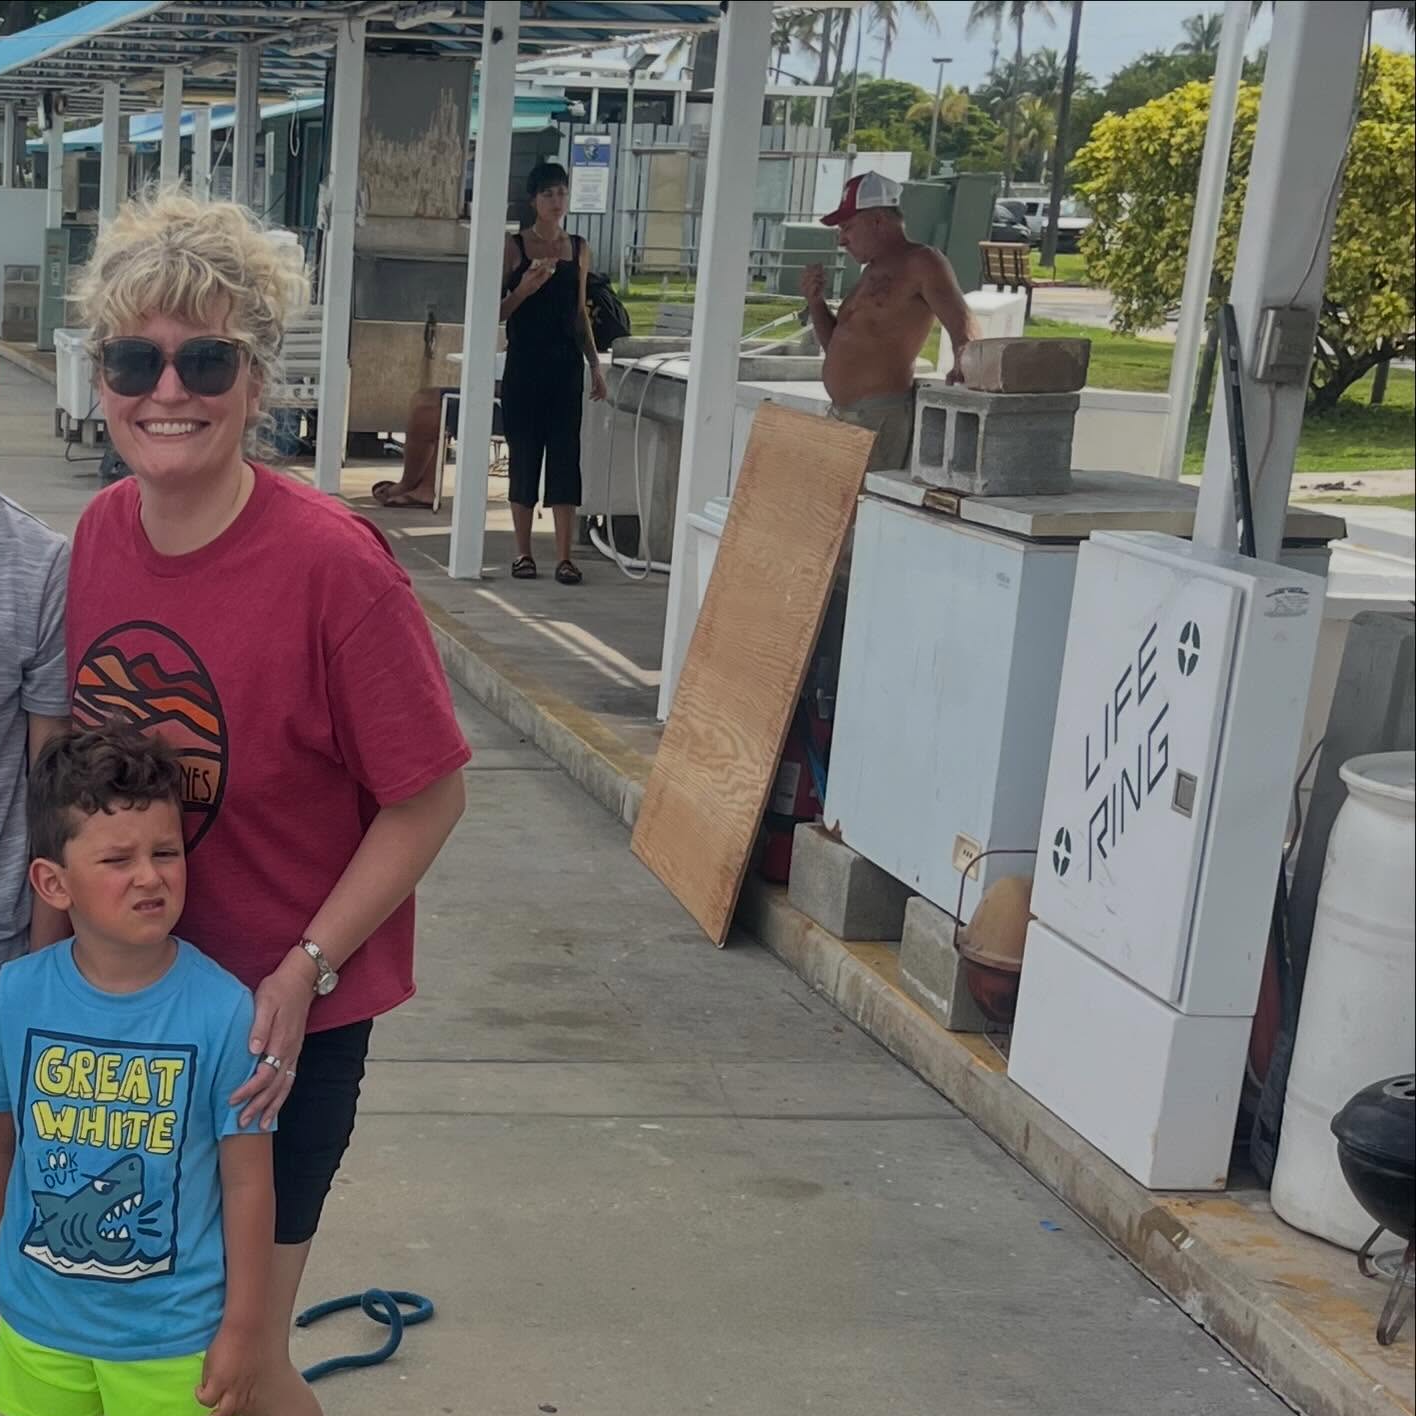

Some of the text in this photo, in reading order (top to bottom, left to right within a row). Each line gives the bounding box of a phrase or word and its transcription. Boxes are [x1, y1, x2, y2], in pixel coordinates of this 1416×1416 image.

[1085, 621, 1158, 792] LIFE
[1087, 701, 1170, 883] RING
[34, 1045, 186, 1108] GREAT
[30, 1099, 178, 1155] WHITE
[43, 1168, 78, 1189] OUT
